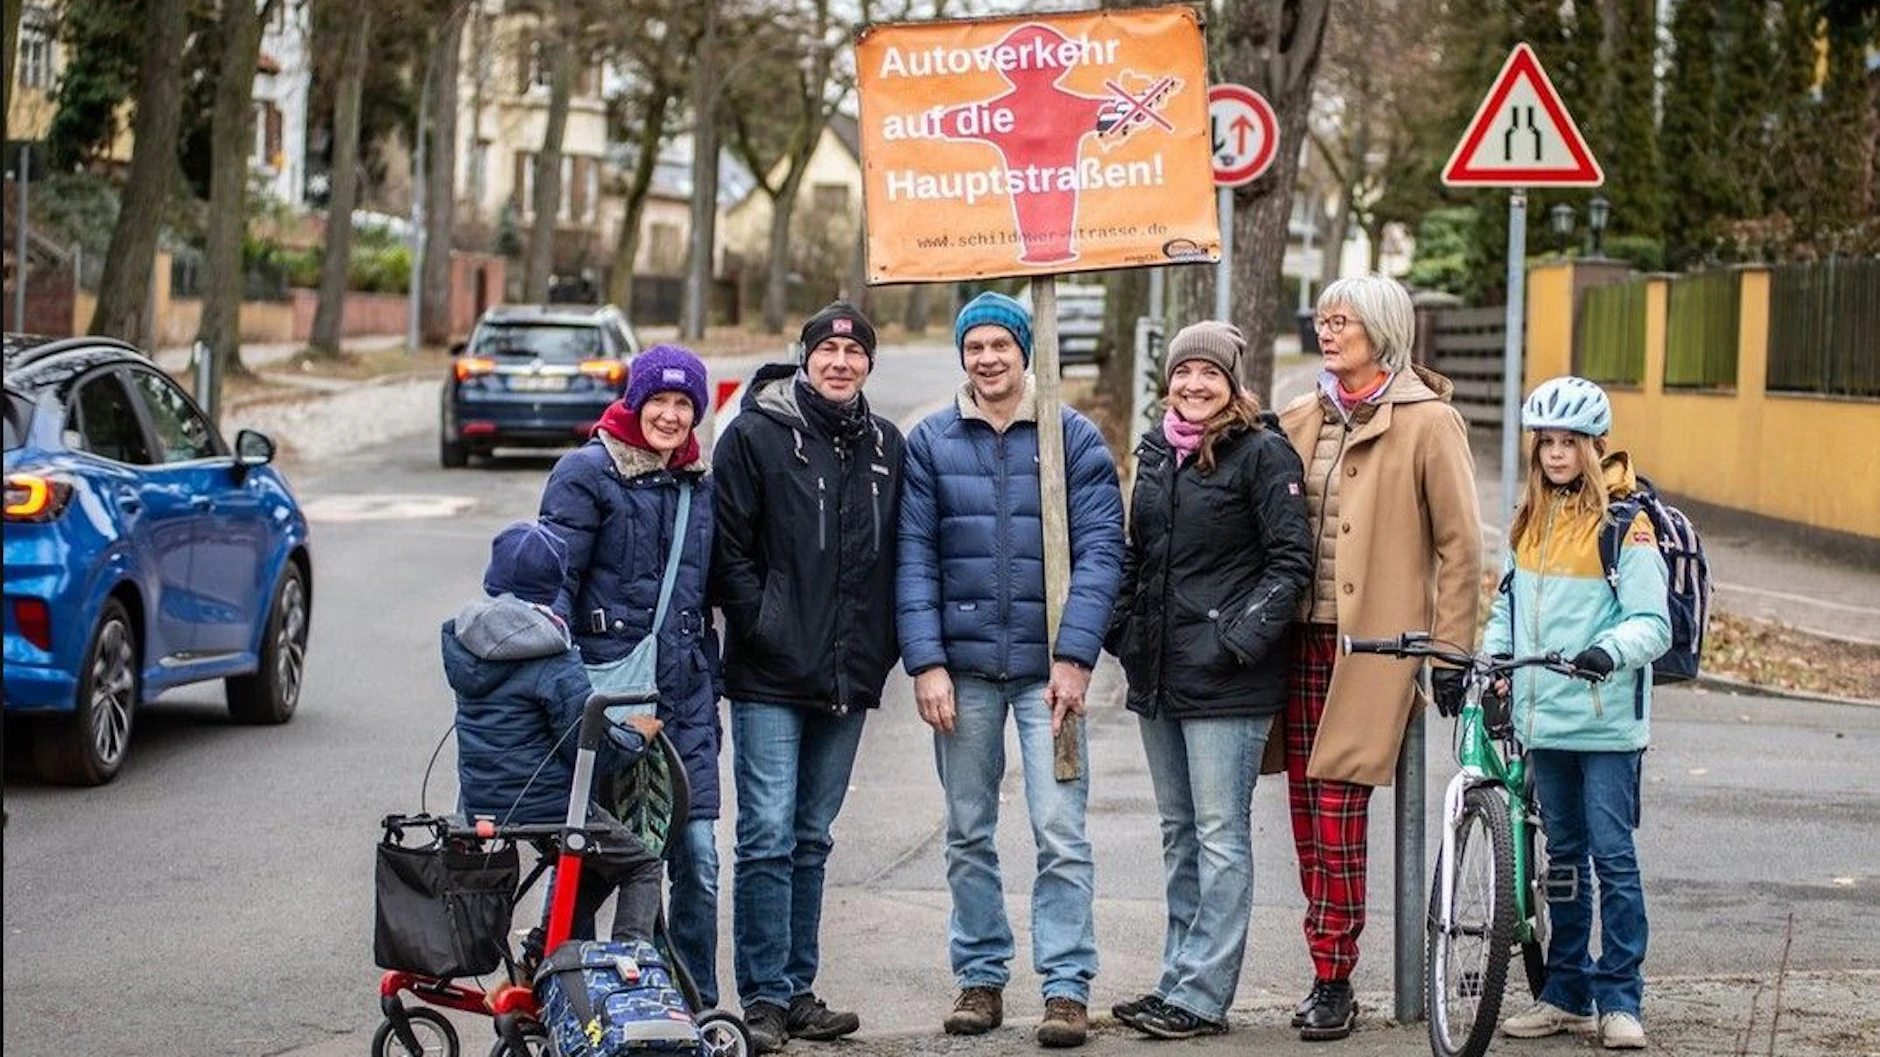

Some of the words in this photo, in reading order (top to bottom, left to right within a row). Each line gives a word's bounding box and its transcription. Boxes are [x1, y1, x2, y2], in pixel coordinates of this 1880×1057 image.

[880, 36, 1119, 78] Autoverkehr
[883, 105, 946, 139] auf
[956, 104, 1015, 135] die
[886, 154, 1164, 204] Hauptstraßen!
